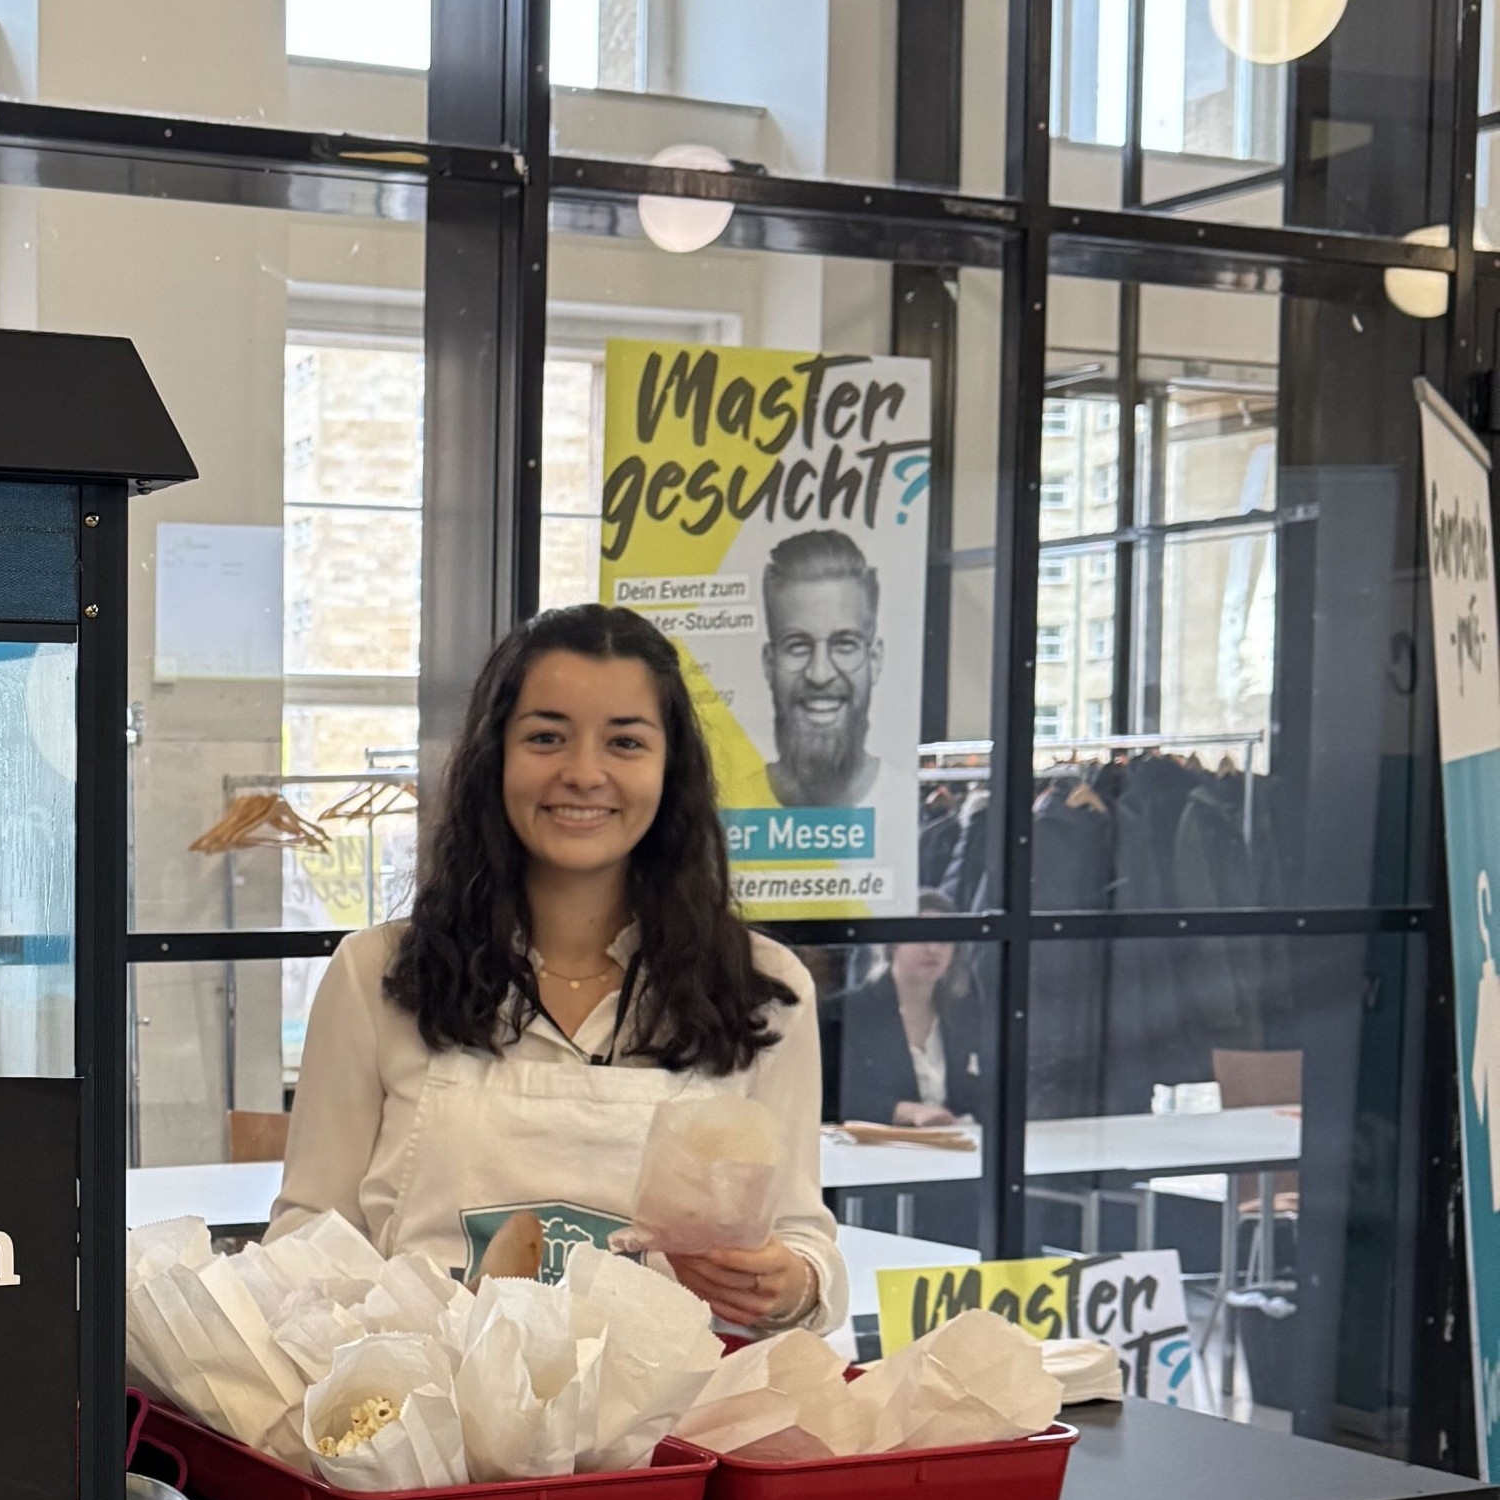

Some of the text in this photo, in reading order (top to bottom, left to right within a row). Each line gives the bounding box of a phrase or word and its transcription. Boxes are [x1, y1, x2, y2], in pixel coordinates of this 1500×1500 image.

[601, 440, 931, 561] gesucht?
[617, 580, 746, 601] Dein Event zum
[652, 609, 754, 632] ter-Studium
[726, 815, 866, 850] er Messe
[737, 872, 884, 898] termessen.de
